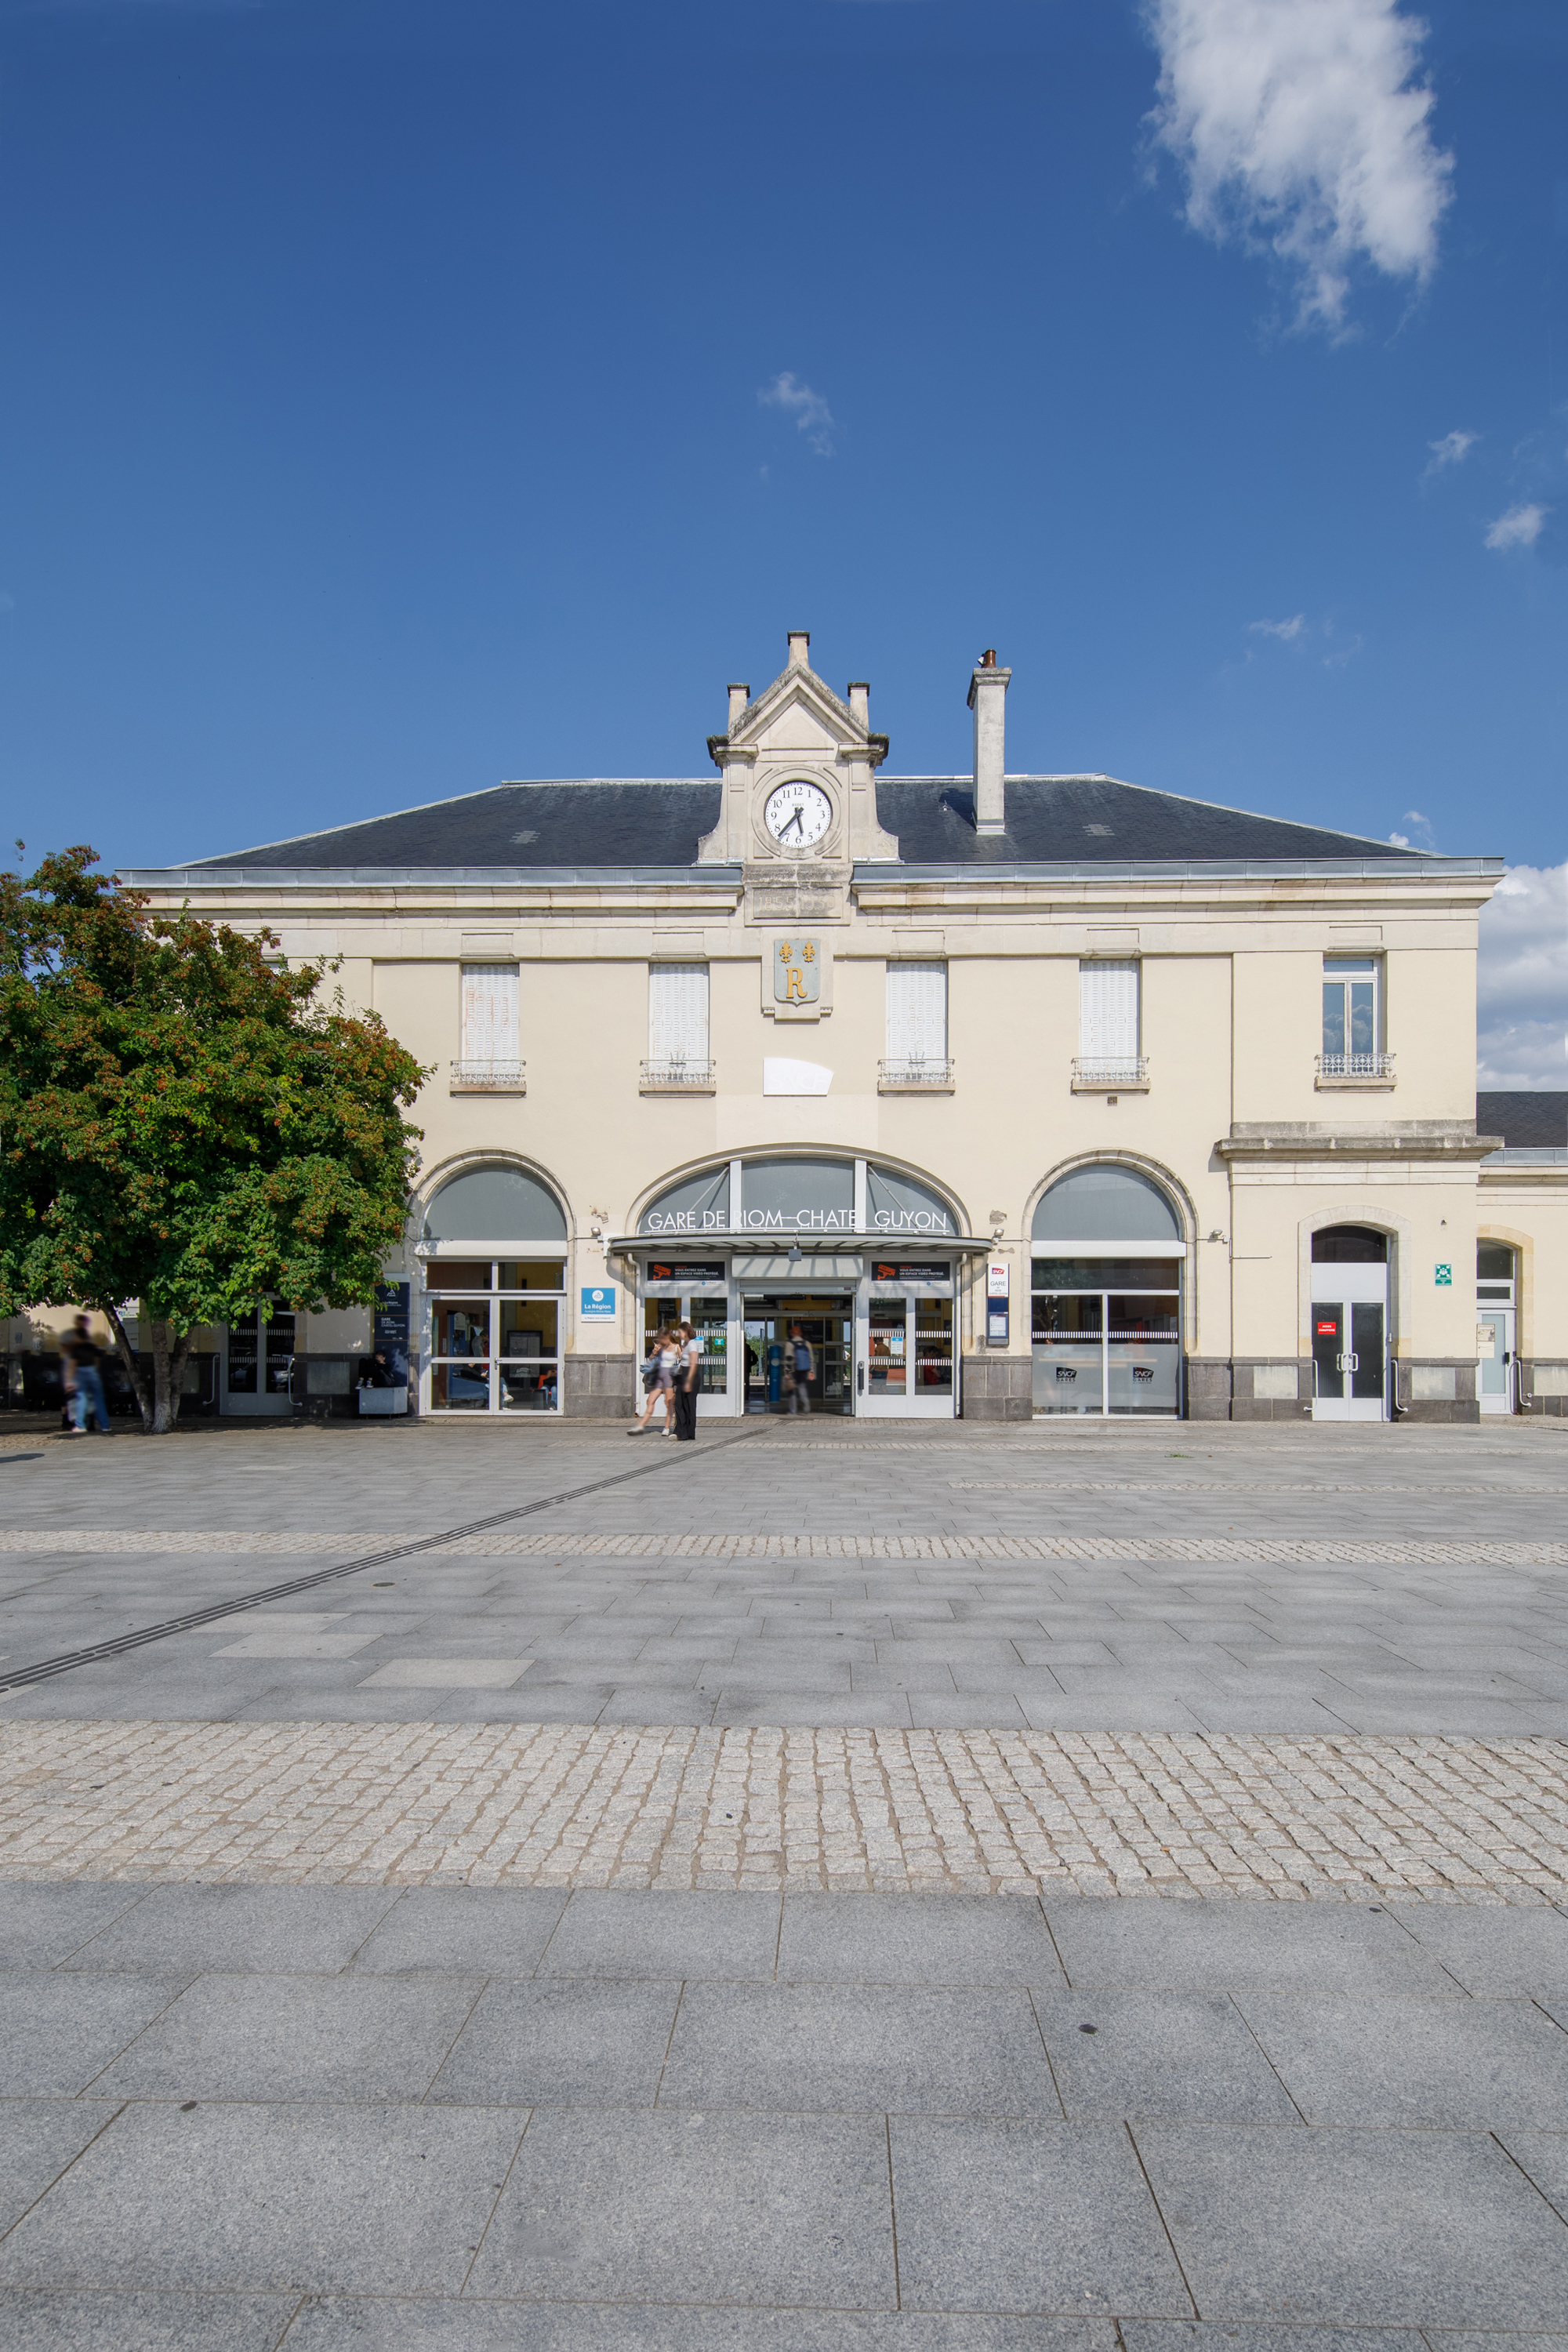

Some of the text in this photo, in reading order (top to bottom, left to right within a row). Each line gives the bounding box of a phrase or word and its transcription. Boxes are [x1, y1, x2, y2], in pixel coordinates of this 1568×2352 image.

[783, 790, 791, 798] 11
[793, 787, 803, 795] 12
[808, 789, 811, 798] 1
[773, 799, 782, 808] 10
[817, 798, 822, 806] 2
[771, 811, 777, 820] 9
[820, 810, 825, 819] 3
[774, 823, 780, 832] 8
[815, 823, 821, 832] 4
[785, 833, 790, 842] 7
[795, 836, 801, 844] 6
[808, 832, 813, 841] 5
[759, 895, 835, 911] 1855 1950
[786, 968, 808, 999] R
[768, 1073, 829, 1091] SNCF
[648, 1211, 696, 1229] GARE
[703, 1210, 725, 1227] DE
[875, 1210, 946, 1229] GUYON
